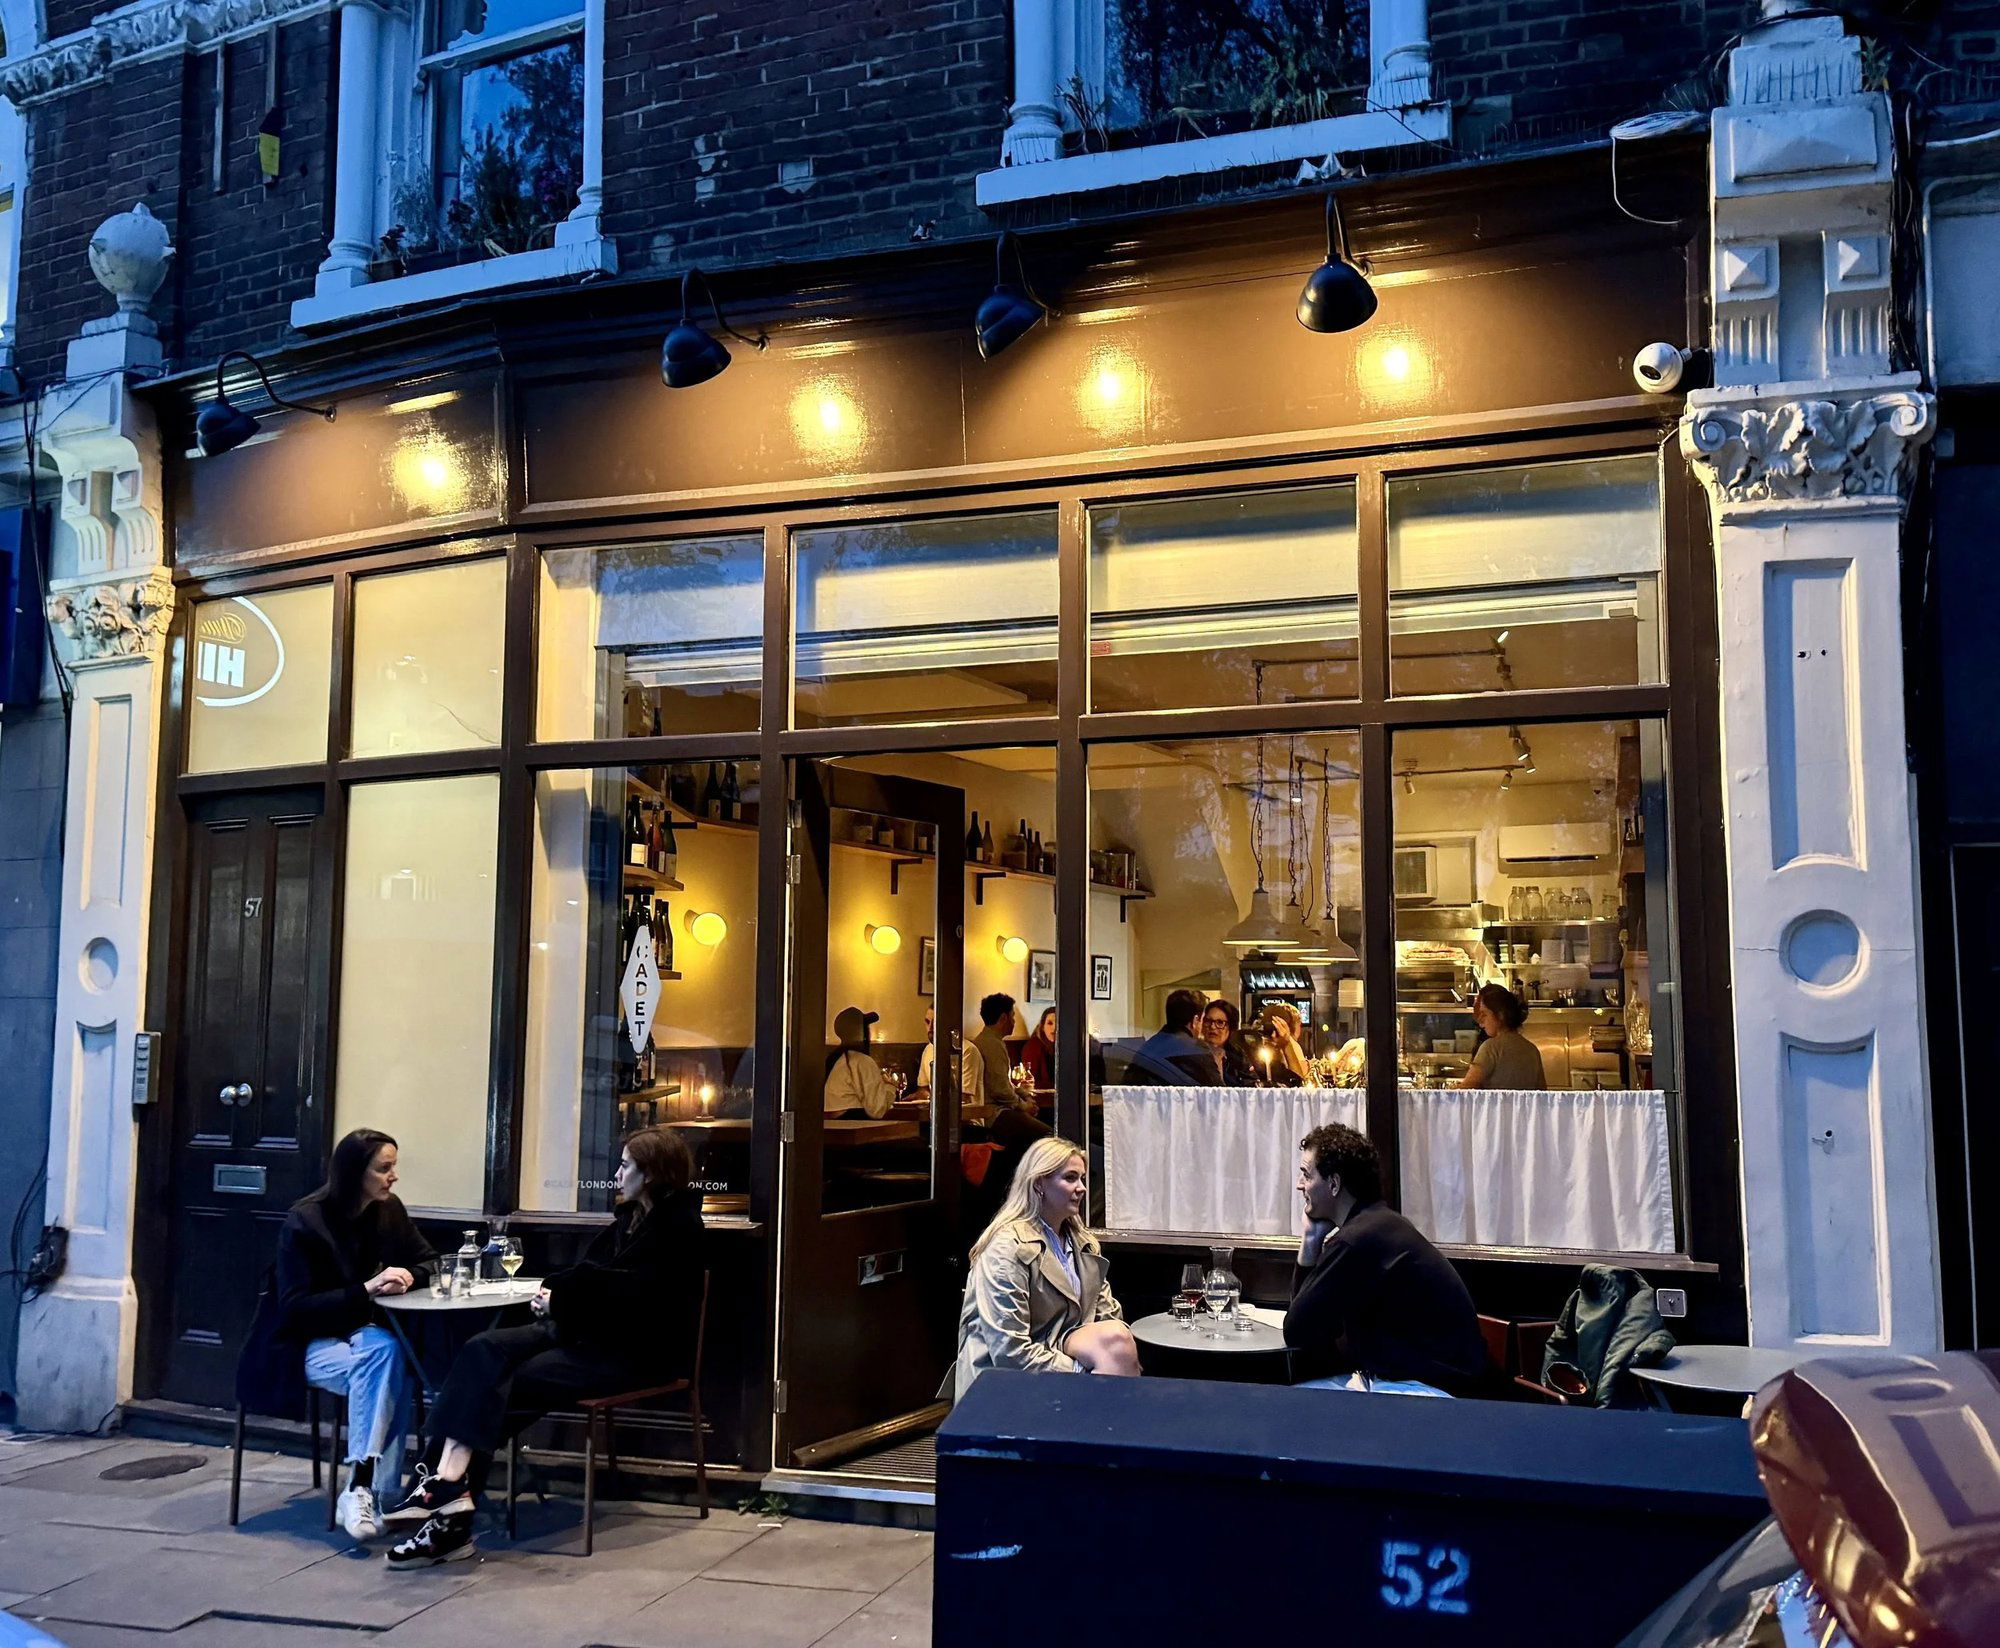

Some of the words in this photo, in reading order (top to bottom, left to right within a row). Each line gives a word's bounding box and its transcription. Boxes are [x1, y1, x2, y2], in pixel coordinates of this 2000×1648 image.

[244, 897, 262, 917] 57
[634, 944, 649, 1037] CADET
[1381, 1541, 1470, 1614] 52
